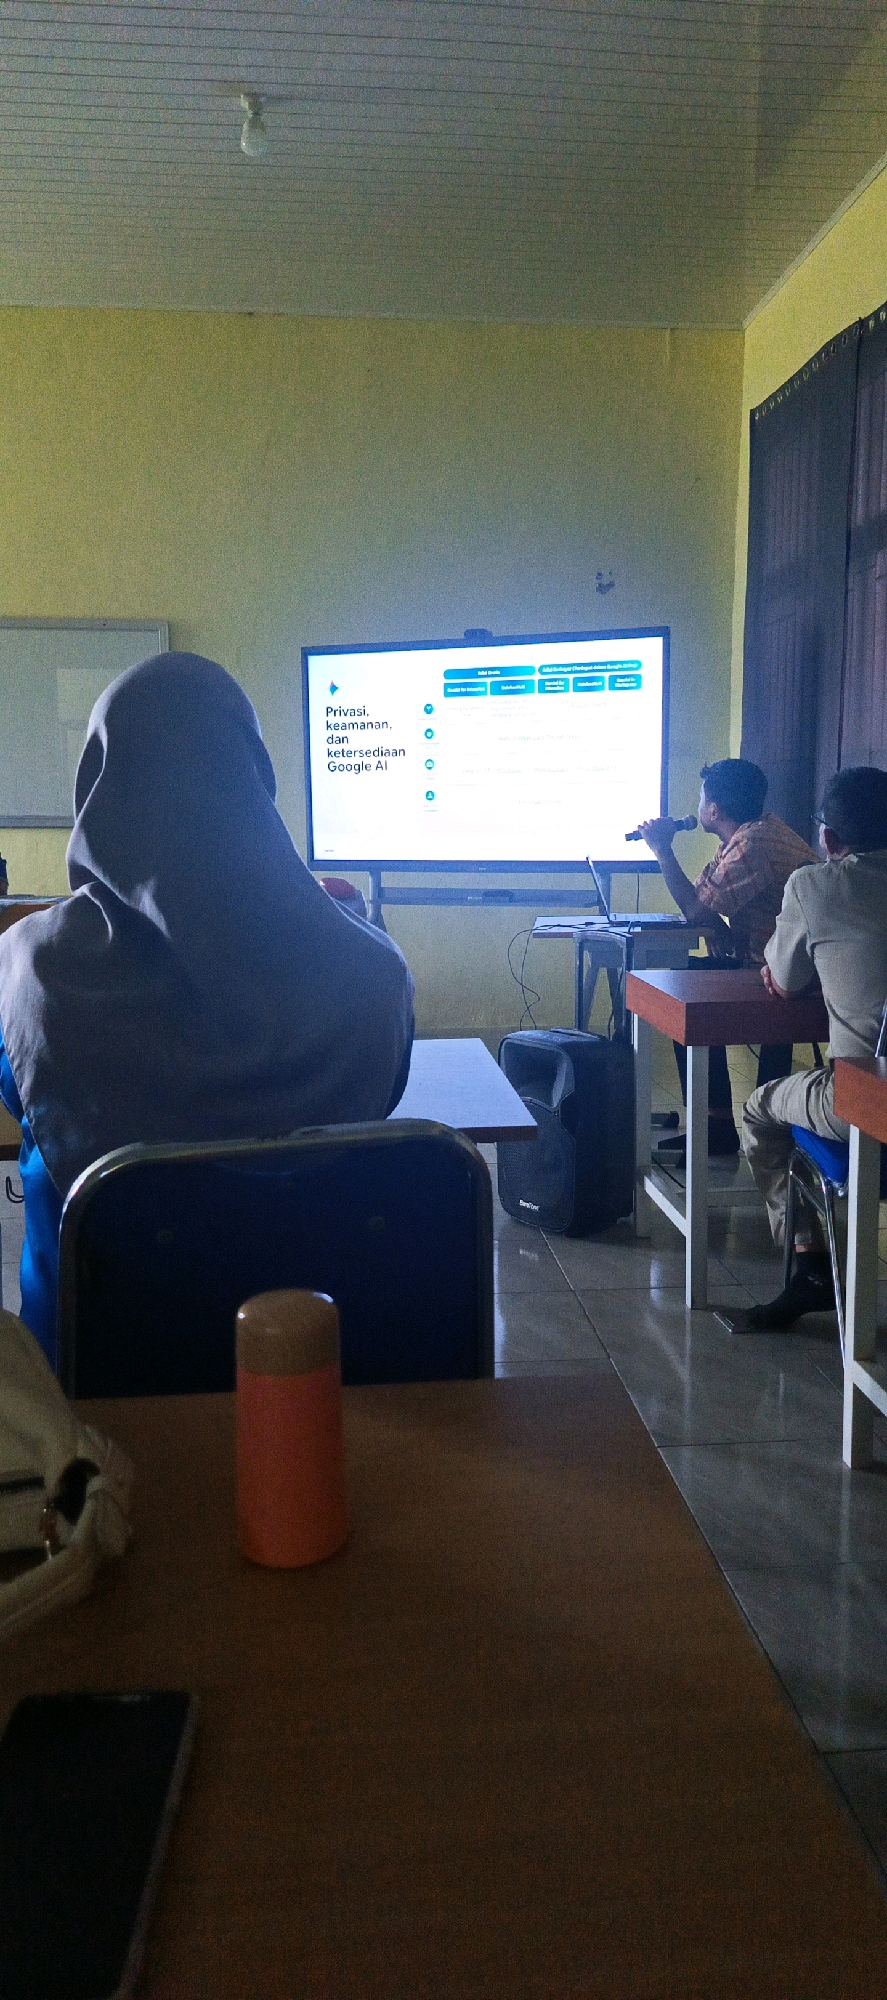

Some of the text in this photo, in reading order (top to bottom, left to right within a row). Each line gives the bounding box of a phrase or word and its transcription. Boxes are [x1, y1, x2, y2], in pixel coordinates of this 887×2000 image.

[326, 706, 369, 717] Privasi,
[326, 720, 392, 731] keamanan,
[326, 734, 349, 745] dan
[327, 746, 406, 758] ketersediaan
[327, 760, 388, 774] Google AI
